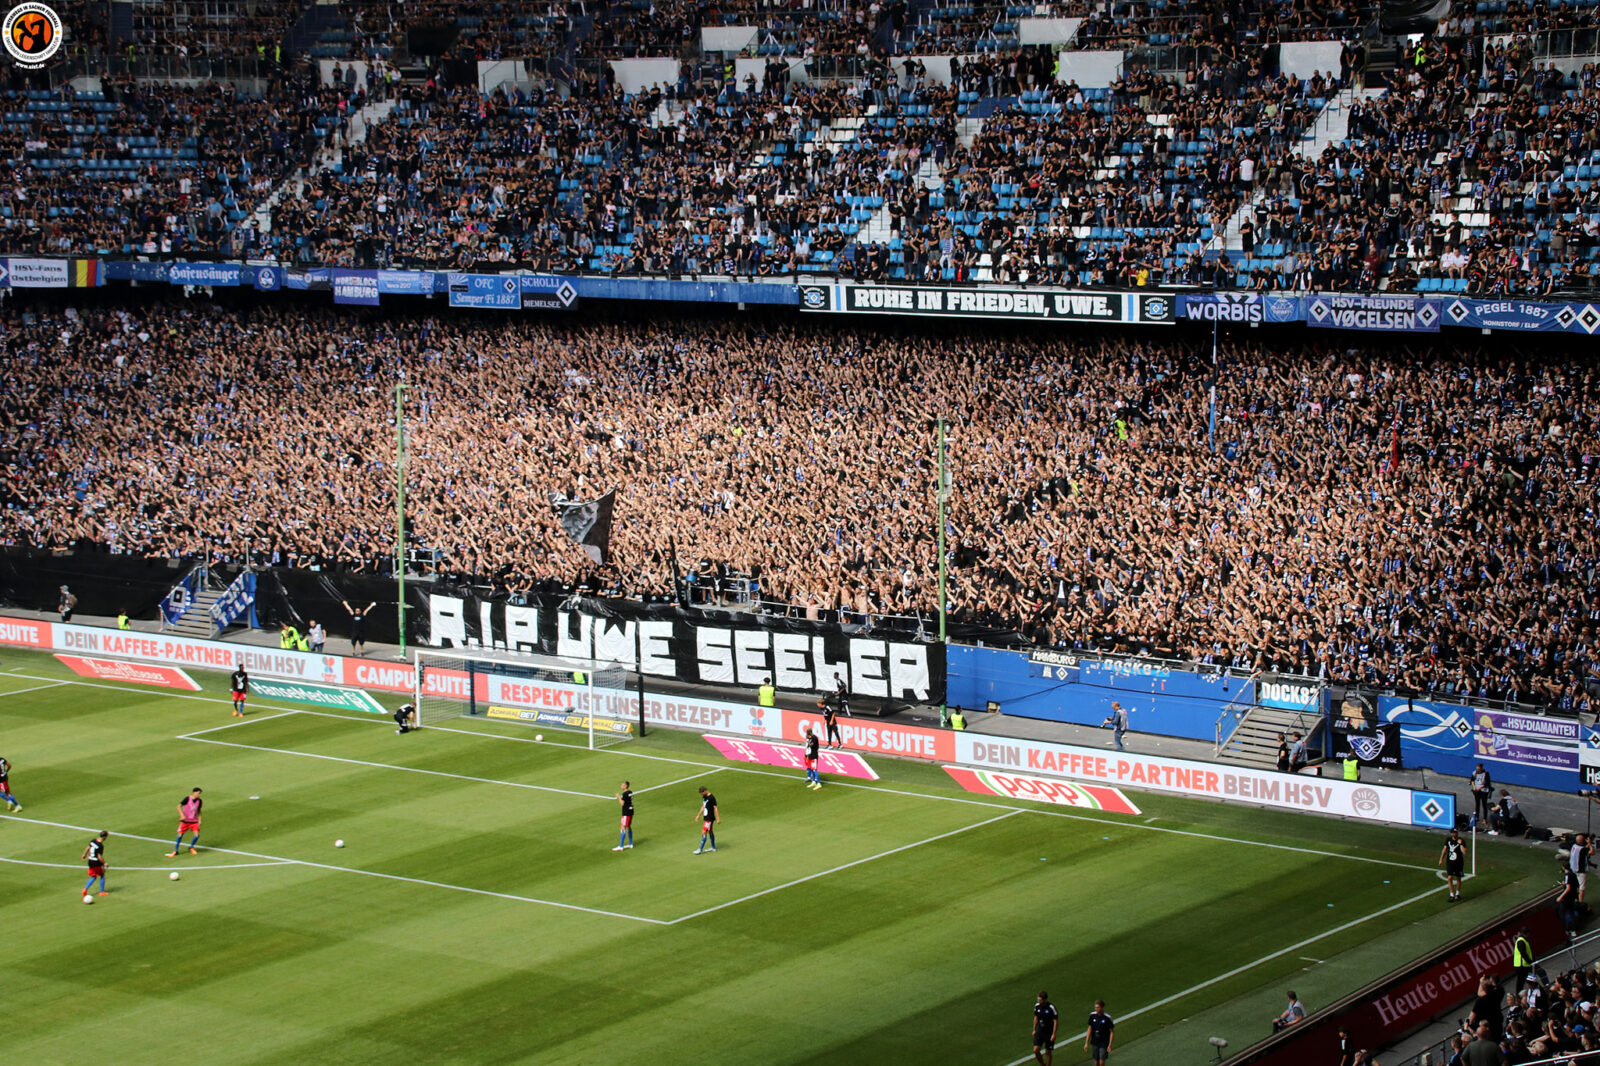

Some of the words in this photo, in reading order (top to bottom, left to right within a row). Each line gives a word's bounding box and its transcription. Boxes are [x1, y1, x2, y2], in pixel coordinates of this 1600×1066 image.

[14, 264, 62, 272] HSV-Fans
[11, 275, 67, 283] Ostbelgien
[521, 277, 560, 288] SCHOLLI
[334, 286, 378, 298] HAMBURG
[455, 293, 483, 306] Semper
[485, 294, 495, 304] Fi
[496, 295, 515, 304] 1887
[523, 300, 561, 308] DIEMELSEE
[854, 289, 913, 309] RUHE
[917, 291, 943, 310] IN
[947, 292, 1049, 317] FRIEDEN,
[1054, 295, 1113, 316] UWE.
[1186, 302, 1262, 322] WORBIS
[1331, 297, 1415, 310] HSV-FREUNDE
[1475, 302, 1515, 316] PEGEL
[1519, 304, 1549, 319] 1887
[0, 623, 39, 643] SUITE
[65, 631, 98, 650] DEIN
[103, 634, 233, 666] KAFFEE-PARTNER
[235, 650, 273, 672] BEIM
[275, 656, 306, 675] HSV
[429, 594, 538, 656] R.I.P.
[556, 610, 676, 678] UWE
[696, 625, 931, 702] SEELER
[1032, 650, 1077, 666] HAMBURG
[356, 665, 421, 690] CAMPU
[426, 673, 471, 696] SUITE
[248, 681, 350, 706] HanseMerkur
[1261, 681, 1320, 706] DOCK87
[501, 683, 574, 707] RESPEKT
[577, 692, 603, 711] IST
[605, 695, 663, 720] UNSER
[666, 702, 733, 728] REZEPT
[1508, 717, 1576, 737] HSV-DIAMANTEN
[881, 728, 936, 756] SUITE
[973, 742, 1020, 766] DEIN
[1027, 748, 1220, 793] KAFFEE-PARTNER
[1223, 773, 1280, 801] BEIM
[1284, 782, 1333, 808] HSV
[1372, 981, 1438, 1027] Heute
[1439, 961, 1472, 992] ein
